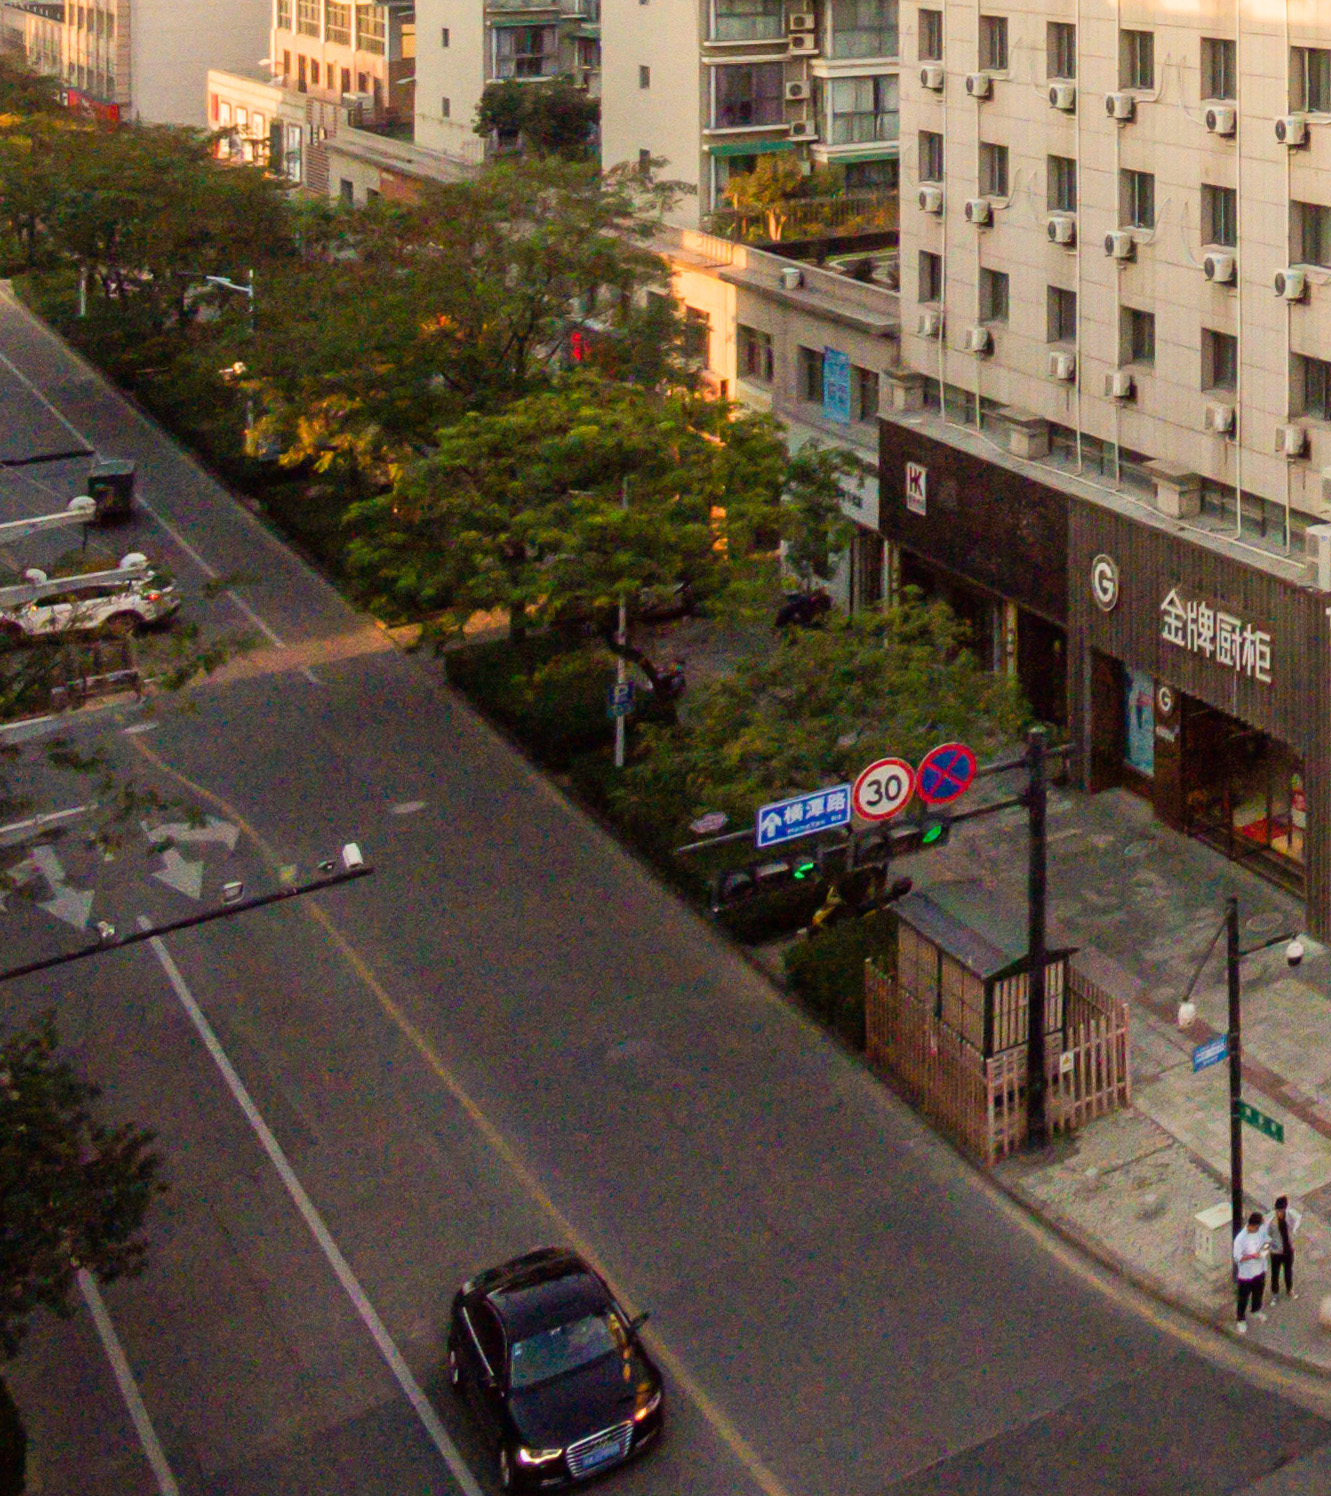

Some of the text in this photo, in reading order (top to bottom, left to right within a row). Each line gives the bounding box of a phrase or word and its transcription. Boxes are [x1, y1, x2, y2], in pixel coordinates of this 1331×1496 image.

[1160, 588, 1272, 684] 金牌厨柜
[865, 774, 902, 807] 30
